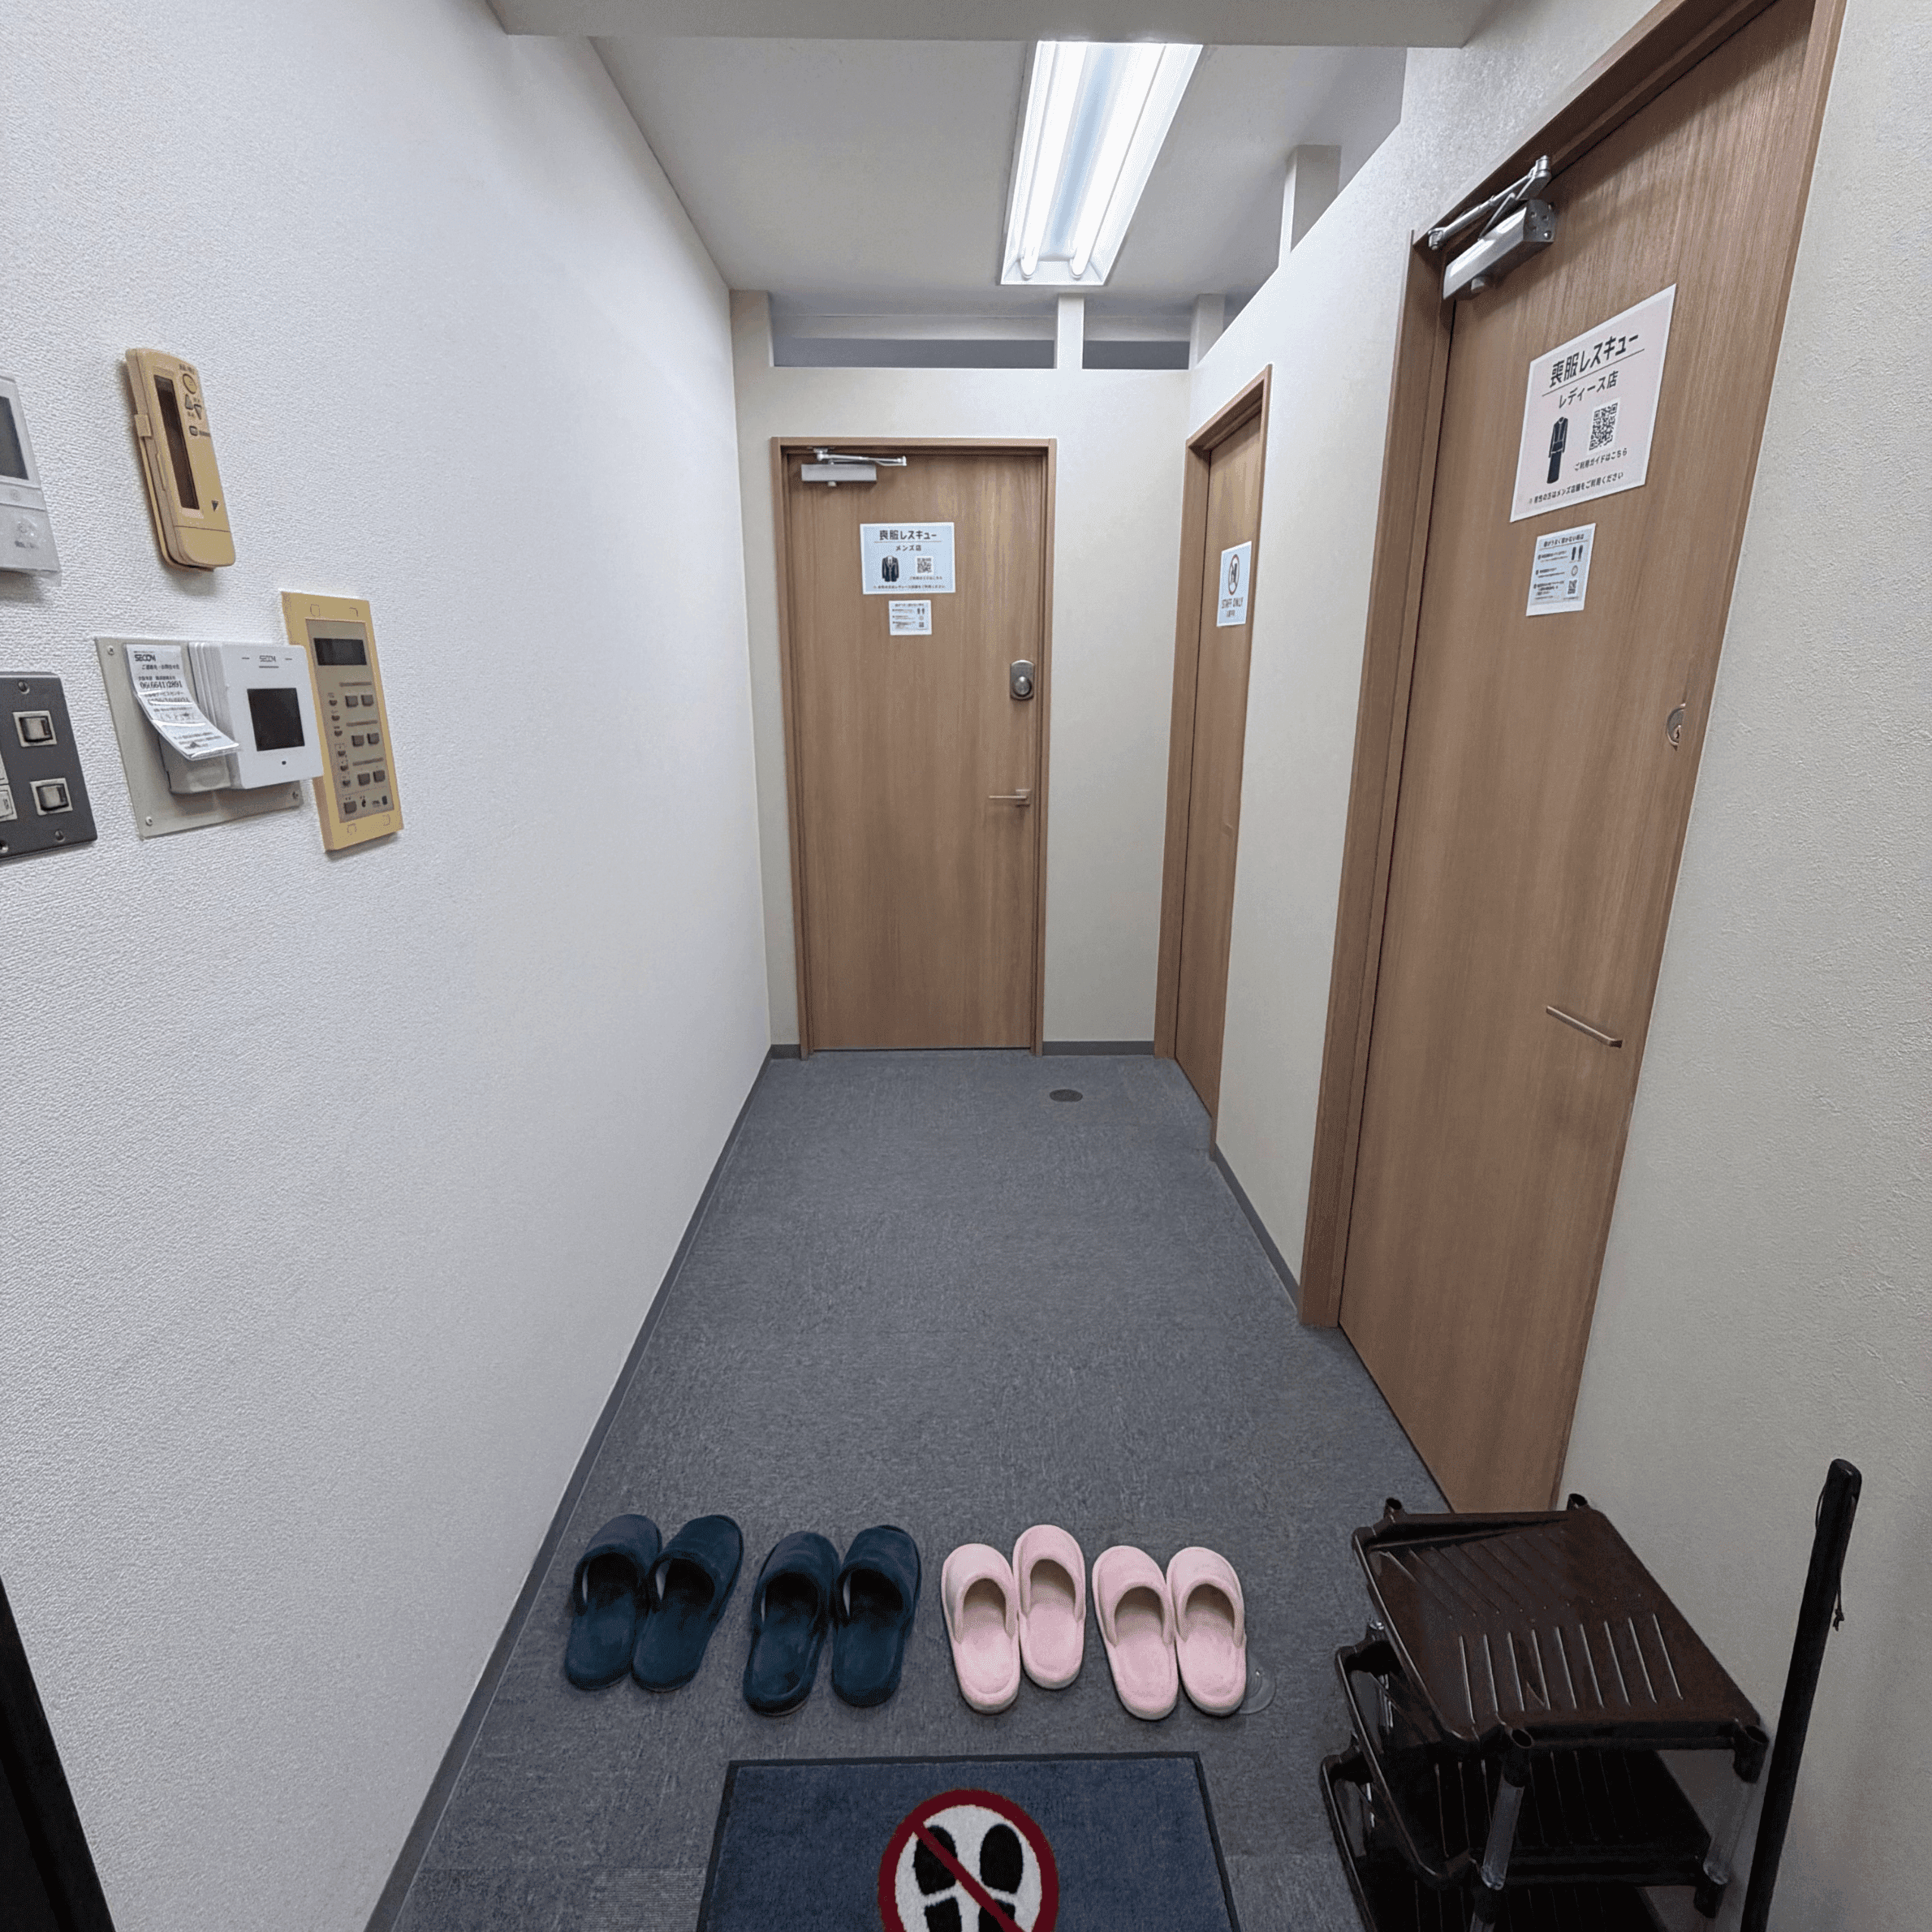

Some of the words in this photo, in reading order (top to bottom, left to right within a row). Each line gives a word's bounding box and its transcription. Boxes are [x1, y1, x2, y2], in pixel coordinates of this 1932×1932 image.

[1549, 334, 1639, 388] 喪服レスキュー
[1558, 371, 1619, 409] レディース店
[1574, 447, 1628, 471] ご利用ガイドはこちら
[879, 529, 937, 541] 喪服レスキュー
[134, 653, 157, 662] SECOM
